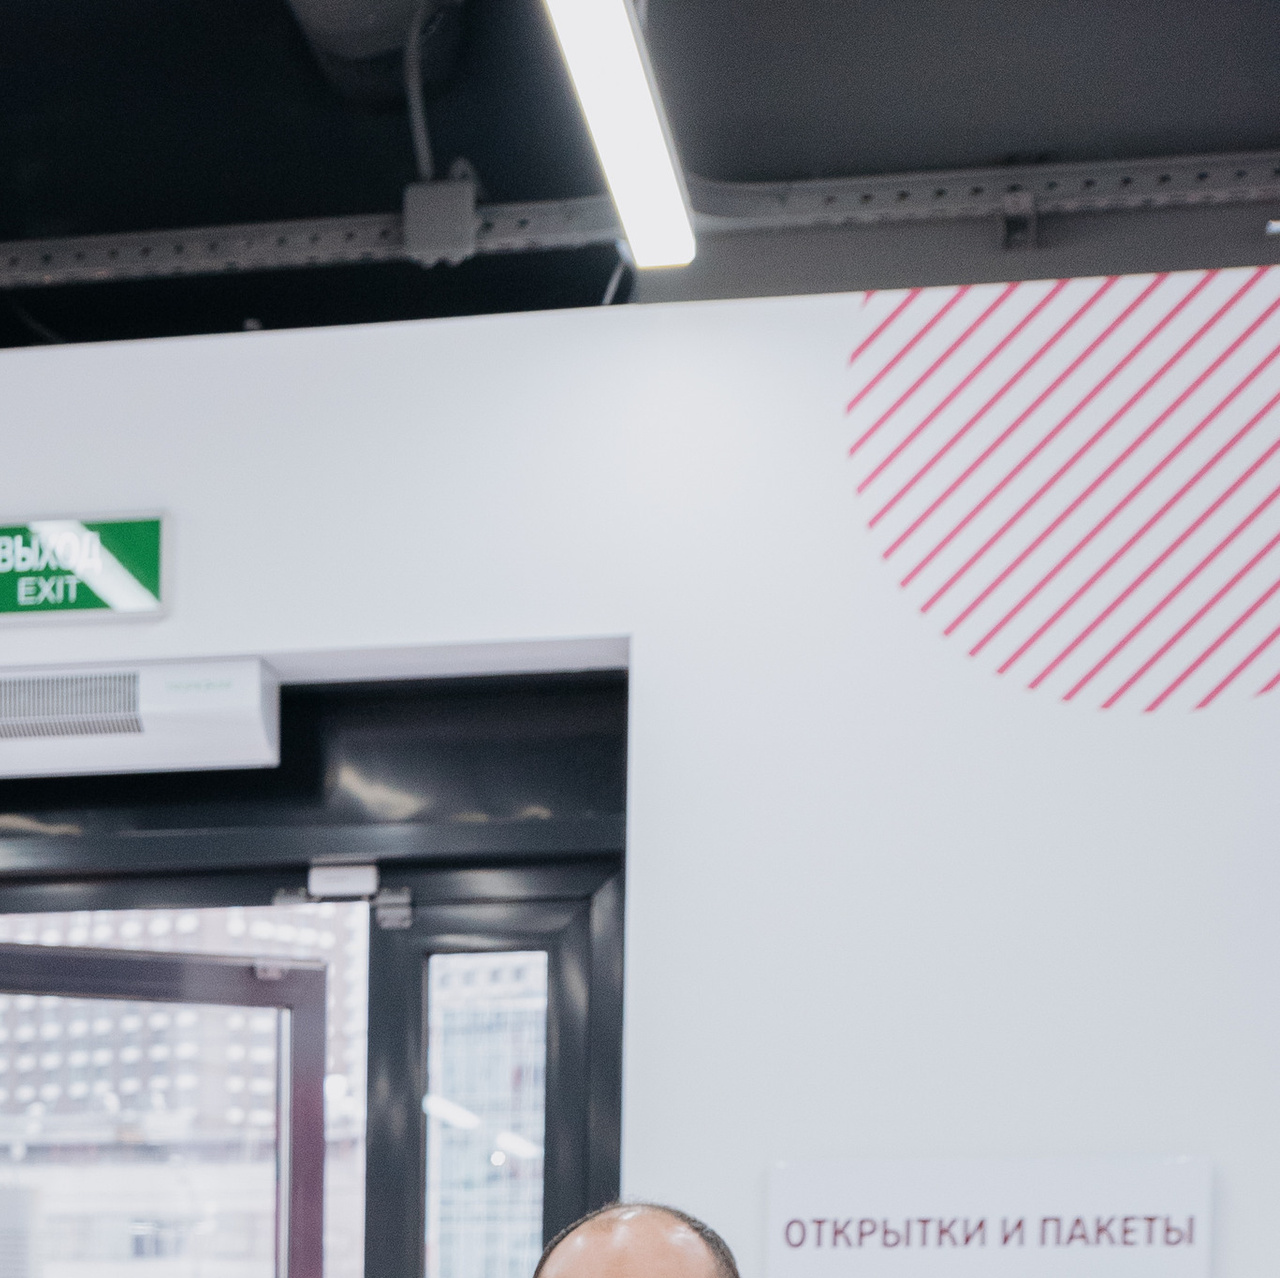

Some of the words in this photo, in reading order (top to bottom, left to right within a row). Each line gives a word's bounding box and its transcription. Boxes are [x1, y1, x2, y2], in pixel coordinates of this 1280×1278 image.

[17, 575, 80, 605] EXIT
[784, 1215, 987, 1249] ОТКРЫТКИ
[1000, 1215, 1026, 1247] И
[1039, 1214, 1196, 1247] ПАКЕТЫ
